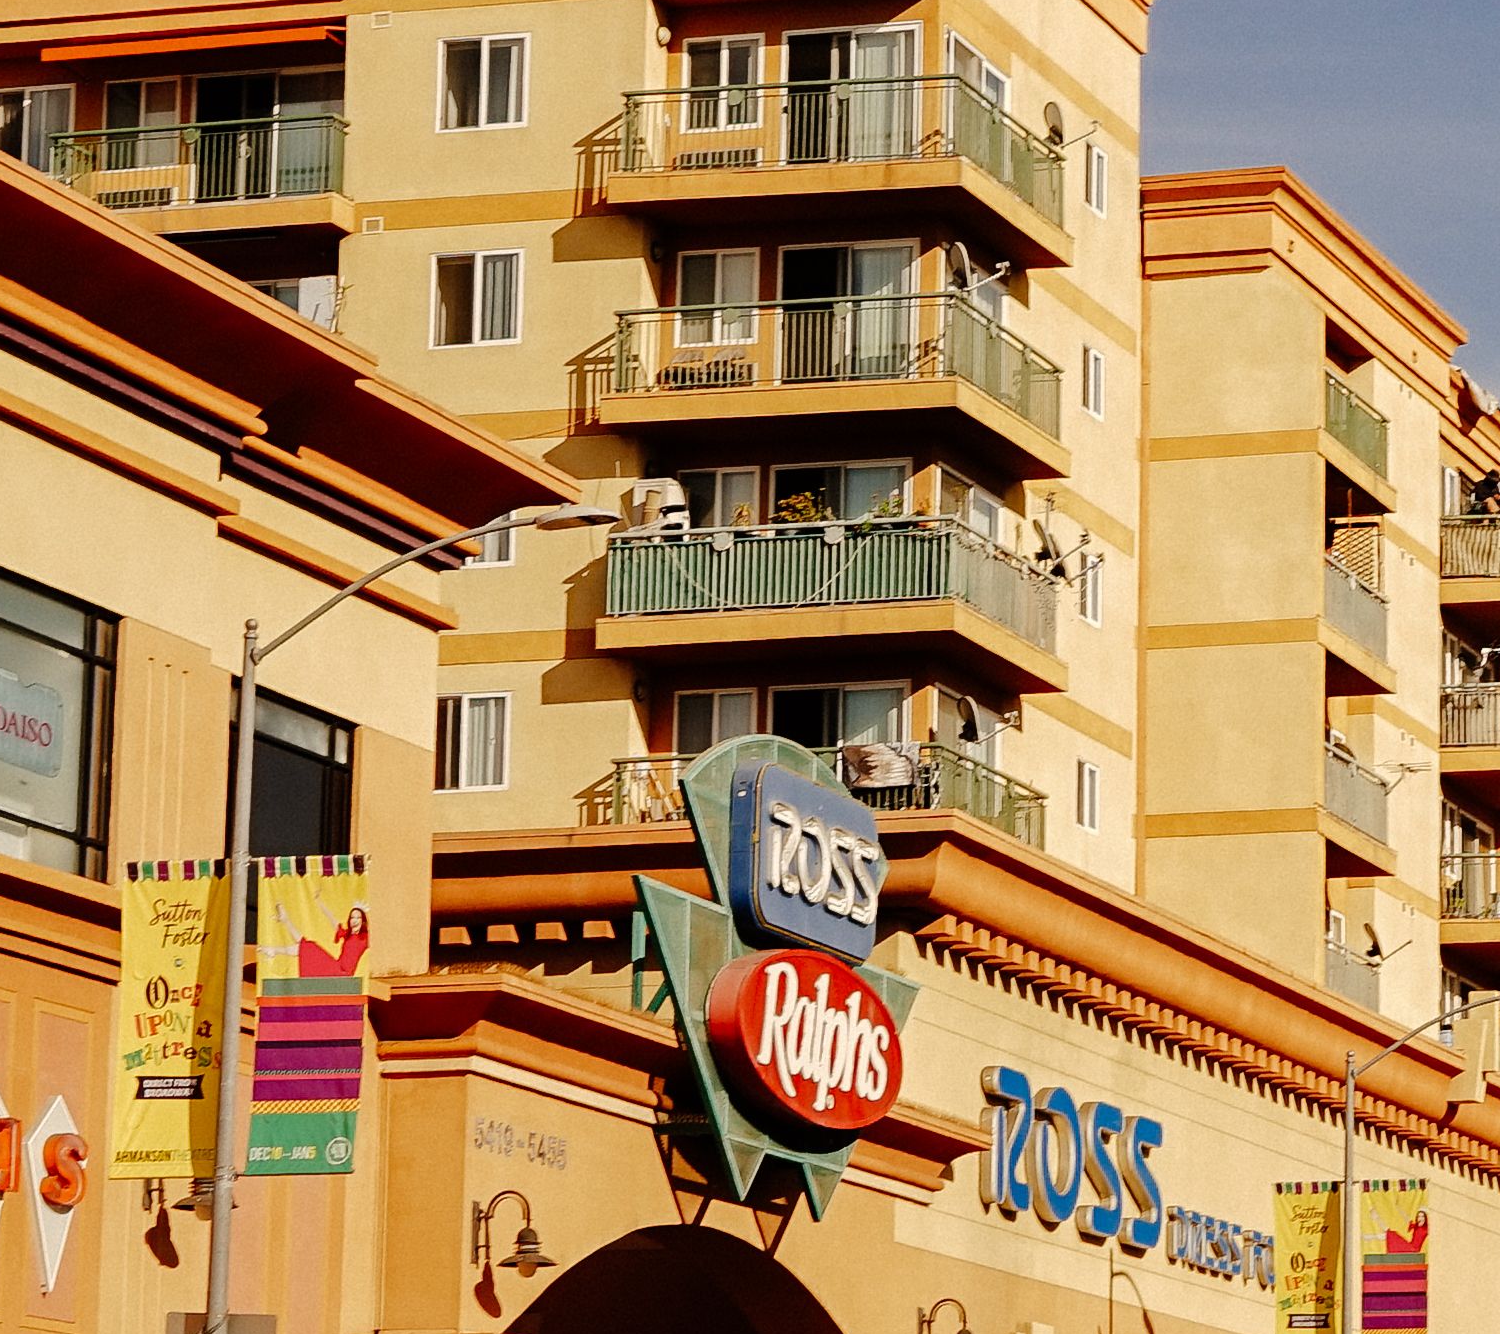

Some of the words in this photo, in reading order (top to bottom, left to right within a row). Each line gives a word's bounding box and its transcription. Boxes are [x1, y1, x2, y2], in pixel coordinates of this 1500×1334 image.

[150, 898, 208, 927] Sutton
[768, 802, 880, 926] ROSS
[161, 924, 211, 949] Foster
[757, 961, 890, 1113] Ralphs
[980, 1065, 1164, 1249] ROSS
[1166, 1204, 1243, 1276] DRESS
